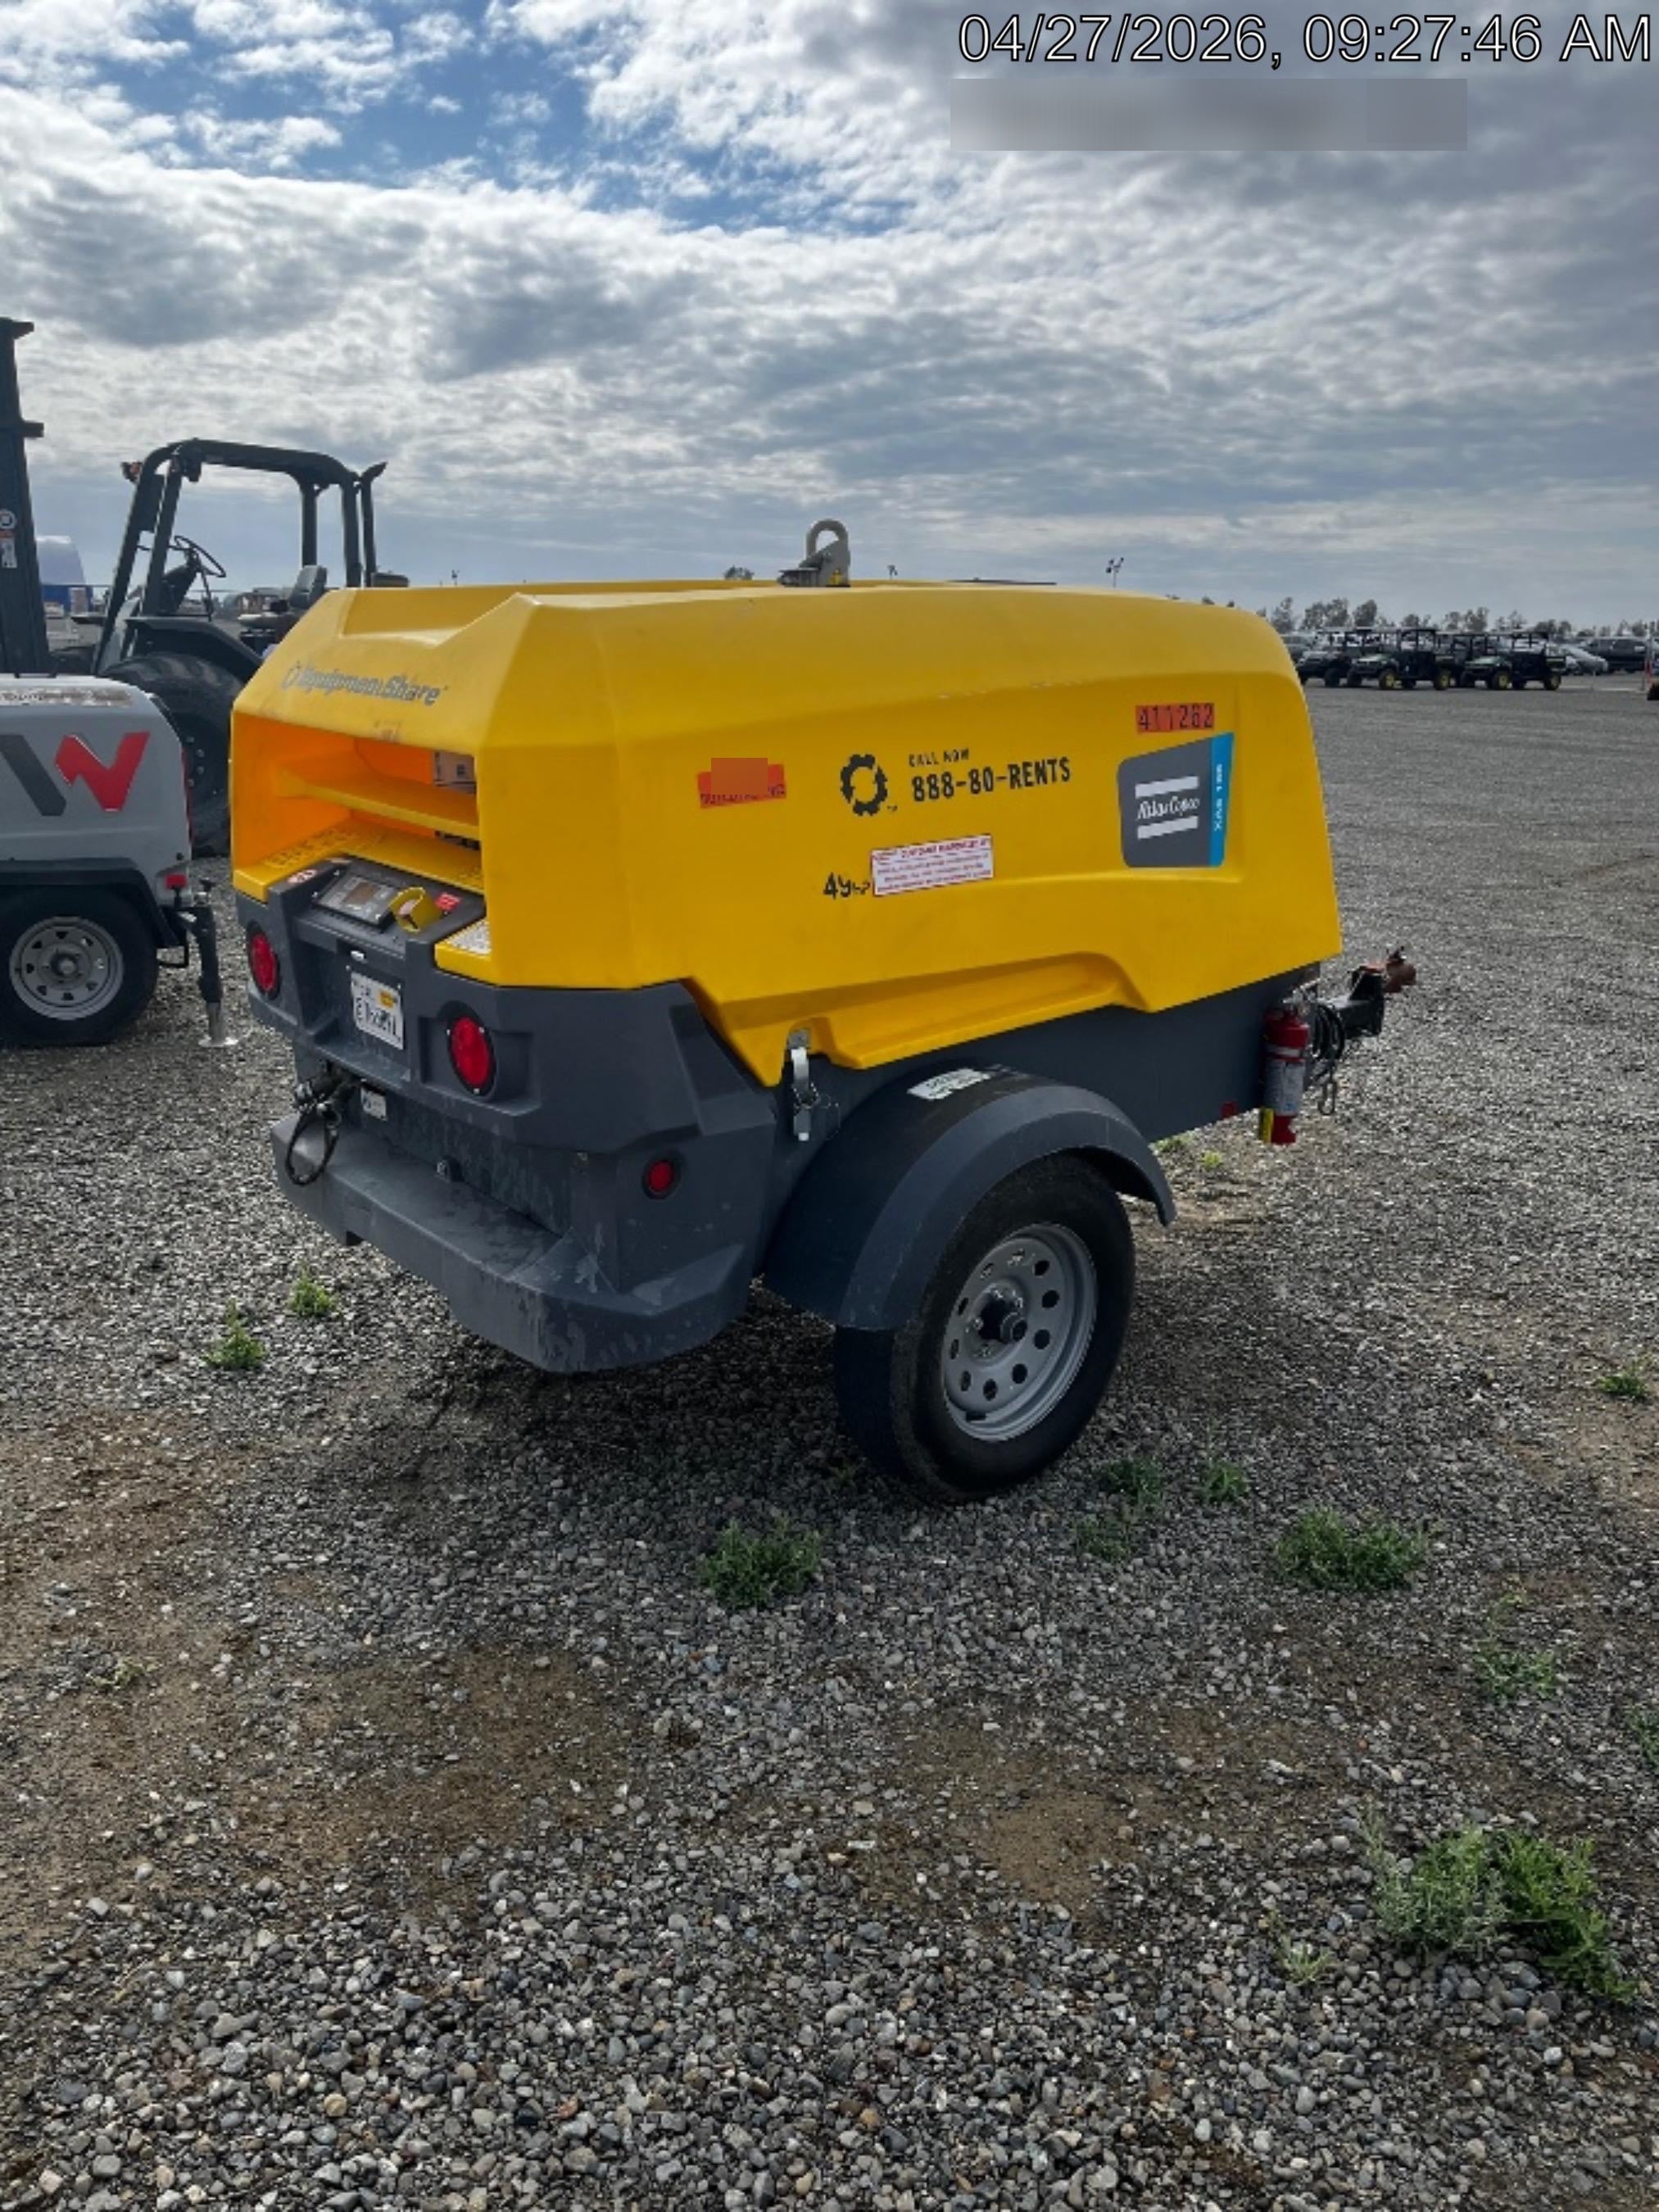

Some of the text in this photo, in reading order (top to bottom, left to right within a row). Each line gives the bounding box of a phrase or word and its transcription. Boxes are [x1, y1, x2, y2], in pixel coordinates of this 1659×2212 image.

[909, 748, 970, 768] CALL NOW
[911, 755, 1071, 802] 888-80-RENTS
